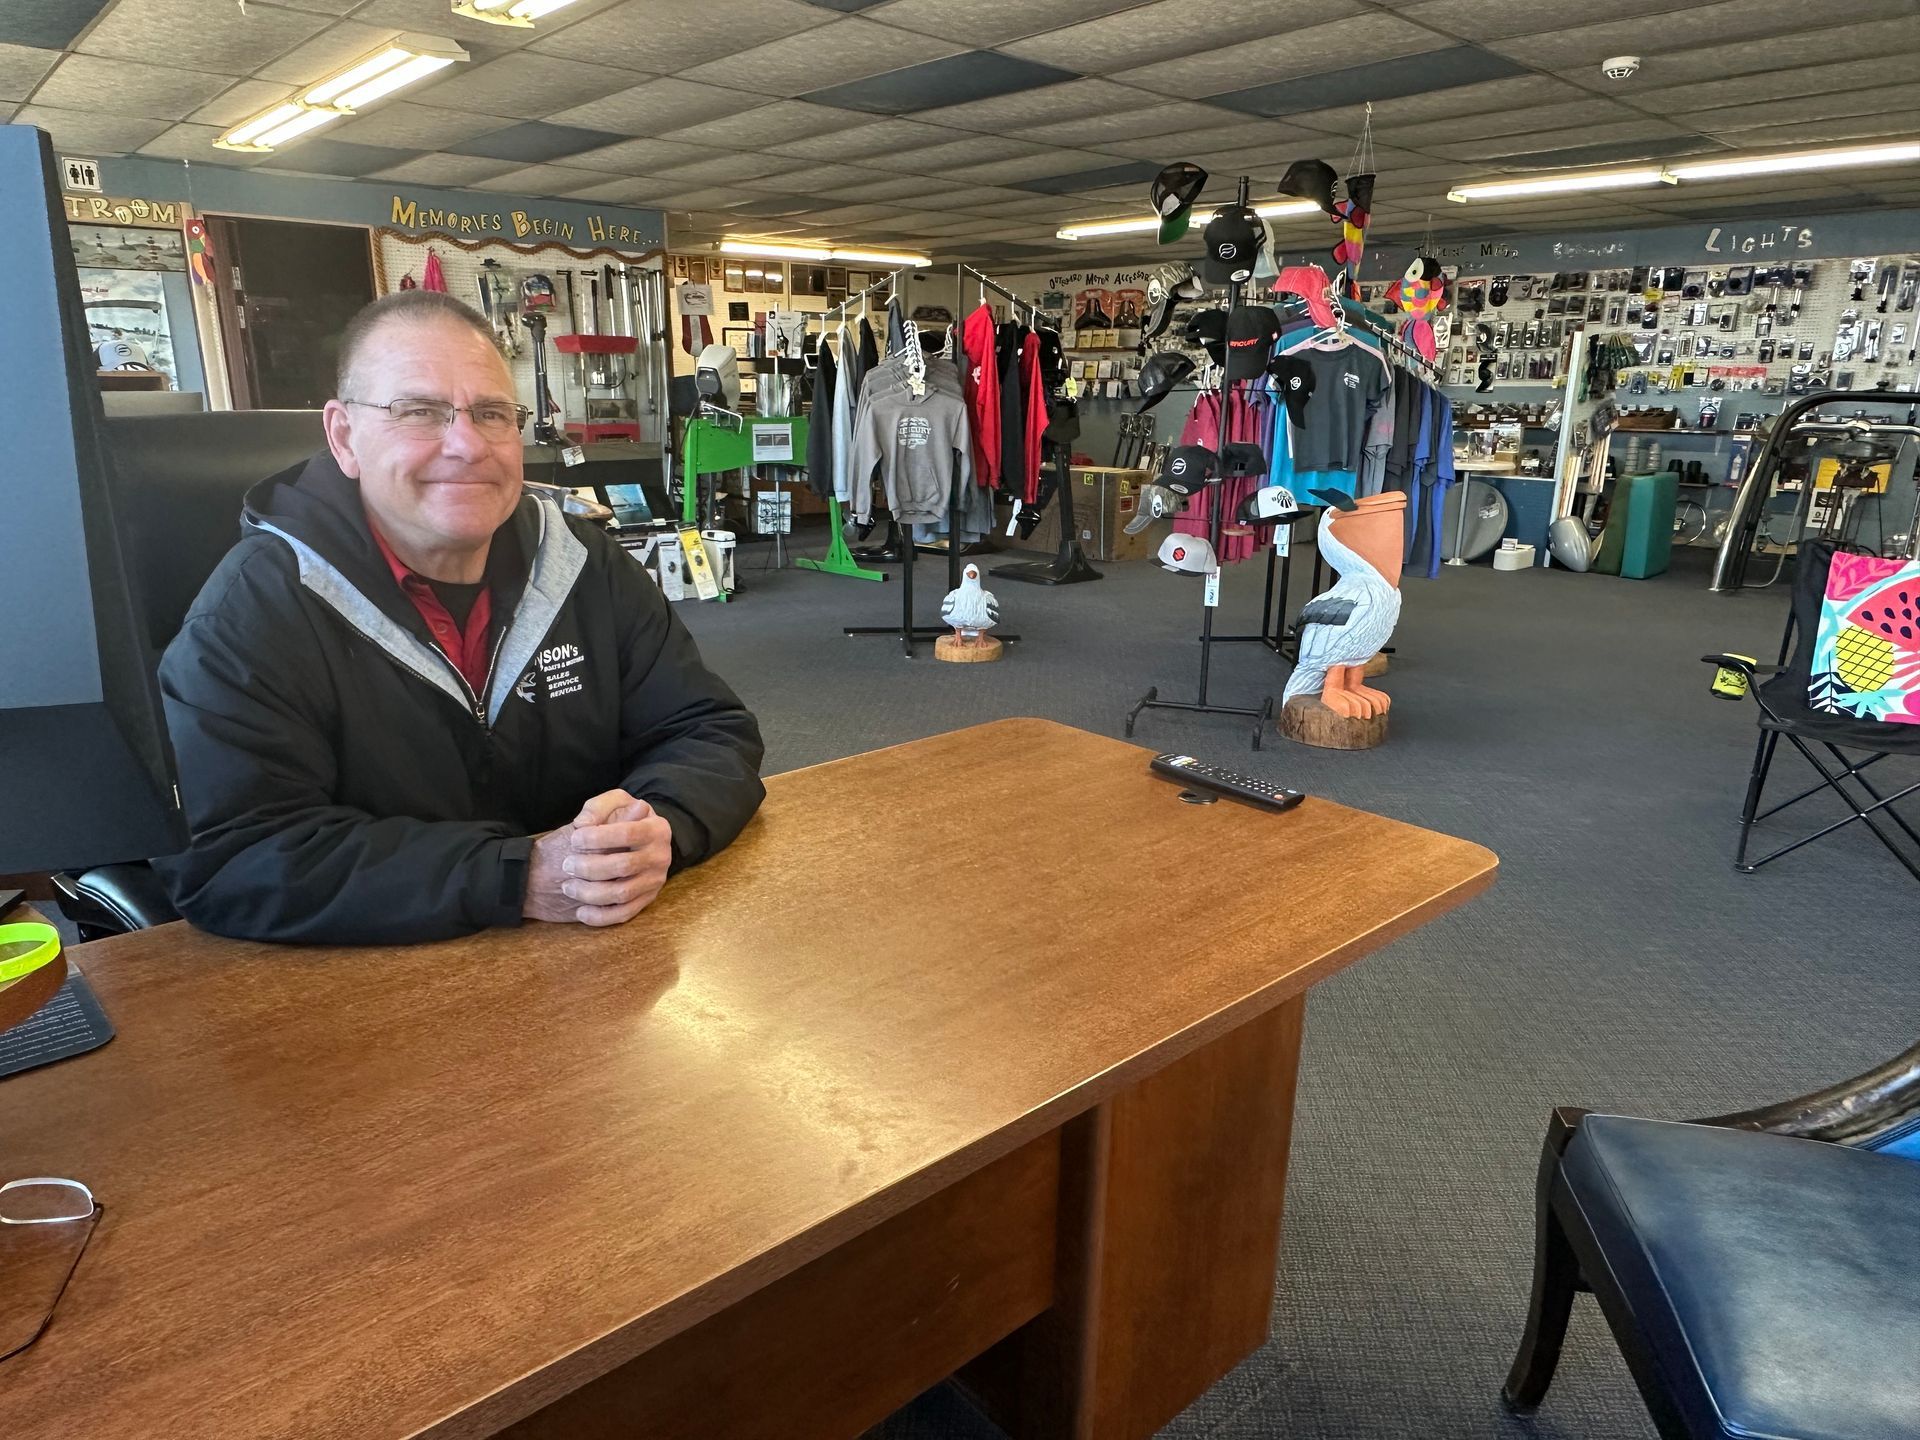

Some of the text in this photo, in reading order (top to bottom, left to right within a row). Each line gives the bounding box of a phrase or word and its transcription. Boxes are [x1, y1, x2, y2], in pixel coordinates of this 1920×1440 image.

[391, 195, 502, 234] MEMORIES
[510, 210, 574, 241] BEGIN
[1705, 226, 1813, 253] LIGHTS
[546, 671, 570, 682] SALES
[548, 676, 579, 690] SERVICE
[550, 684, 582, 698] RENTALS
